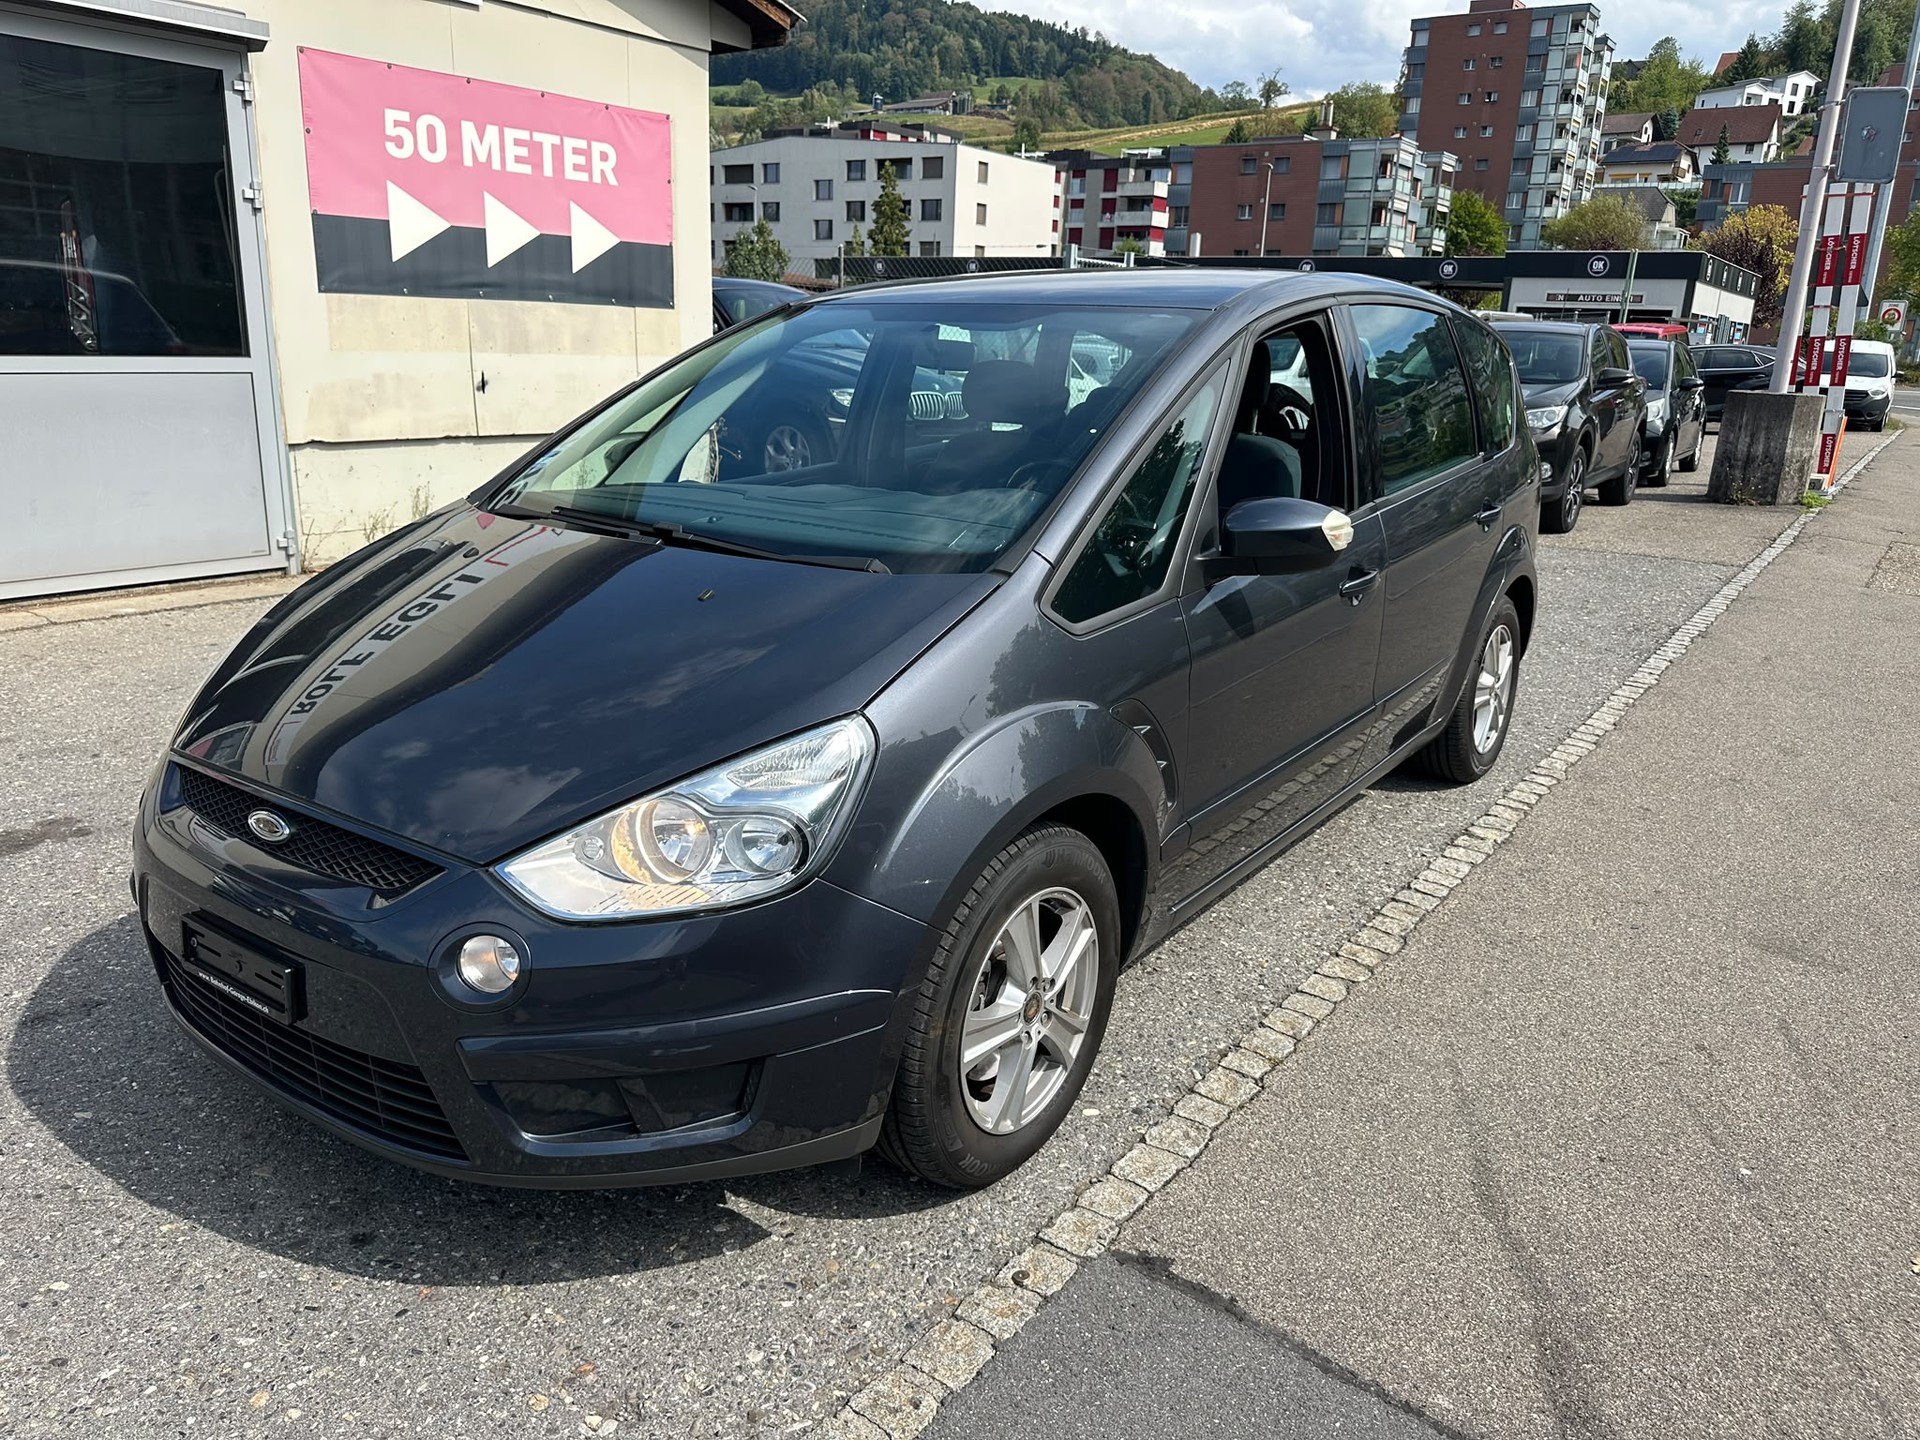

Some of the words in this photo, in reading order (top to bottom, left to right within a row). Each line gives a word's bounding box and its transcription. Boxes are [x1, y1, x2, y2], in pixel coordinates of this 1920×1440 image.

[384, 107, 448, 164] 50
[460, 119, 619, 187] METER
[1592, 260, 1605, 270] OK
[1577, 294, 1603, 302] AUTO
